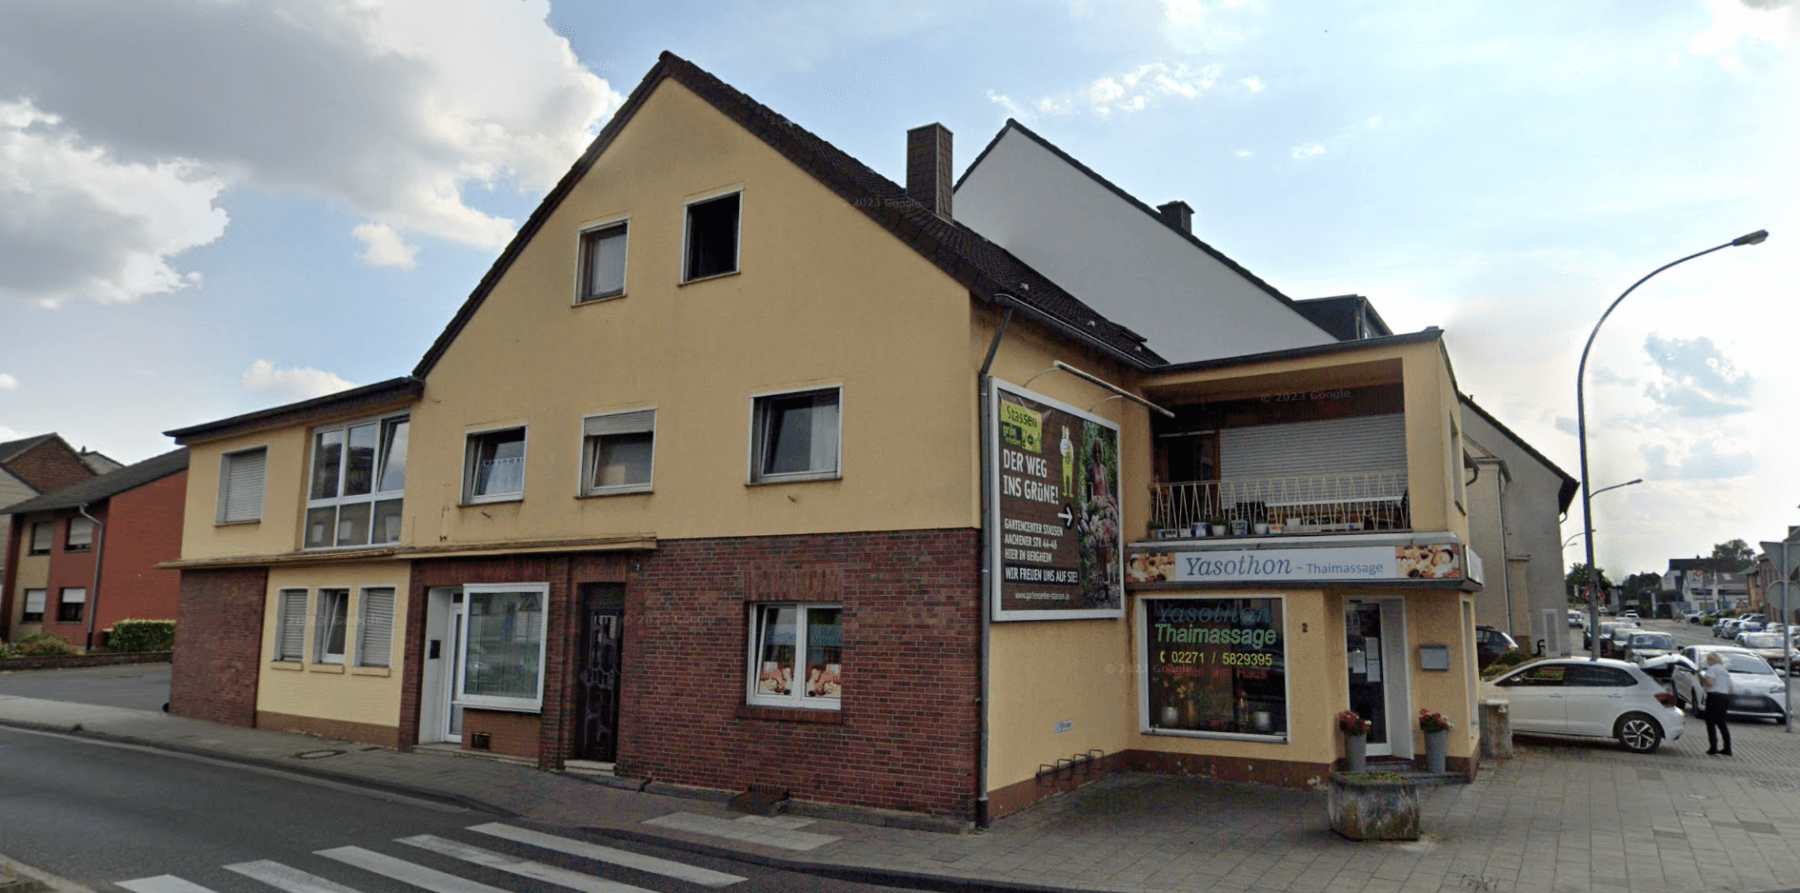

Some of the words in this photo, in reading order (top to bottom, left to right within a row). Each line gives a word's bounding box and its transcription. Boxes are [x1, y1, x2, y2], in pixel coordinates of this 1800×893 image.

[1006, 404, 1037, 428] Stassen
[1003, 448, 1024, 472] DER
[1025, 454, 1048, 478] WEG
[1003, 475, 1022, 498] INS
[1004, 518, 1042, 534] GARTENCENTER
[1042, 523, 1064, 537] STASSEN
[1004, 533, 1032, 547] AACHENER
[1004, 547, 1019, 560] HIER
[1019, 549, 1026, 561] IN
[1026, 550, 1052, 563] BERGHEIM
[1005, 566, 1019, 580] WIR
[1019, 567, 1042, 581] FREUEN
[1043, 569, 1055, 582] UNS
[1055, 570, 1067, 582] AUF
[1067, 571, 1078, 583] SIE!
[1186, 555, 1293, 576] Yasothon
[1306, 562, 1384, 576] Thaimassage
[1158, 603, 1272, 624] Yasothon
[1155, 623, 1277, 649] Thaimassage
[1302, 622, 1309, 633] 2
[1171, 651, 1205, 664] 02271
[1222, 652, 1274, 666] 5829395
[1235, 666, 1268, 680] Haus
